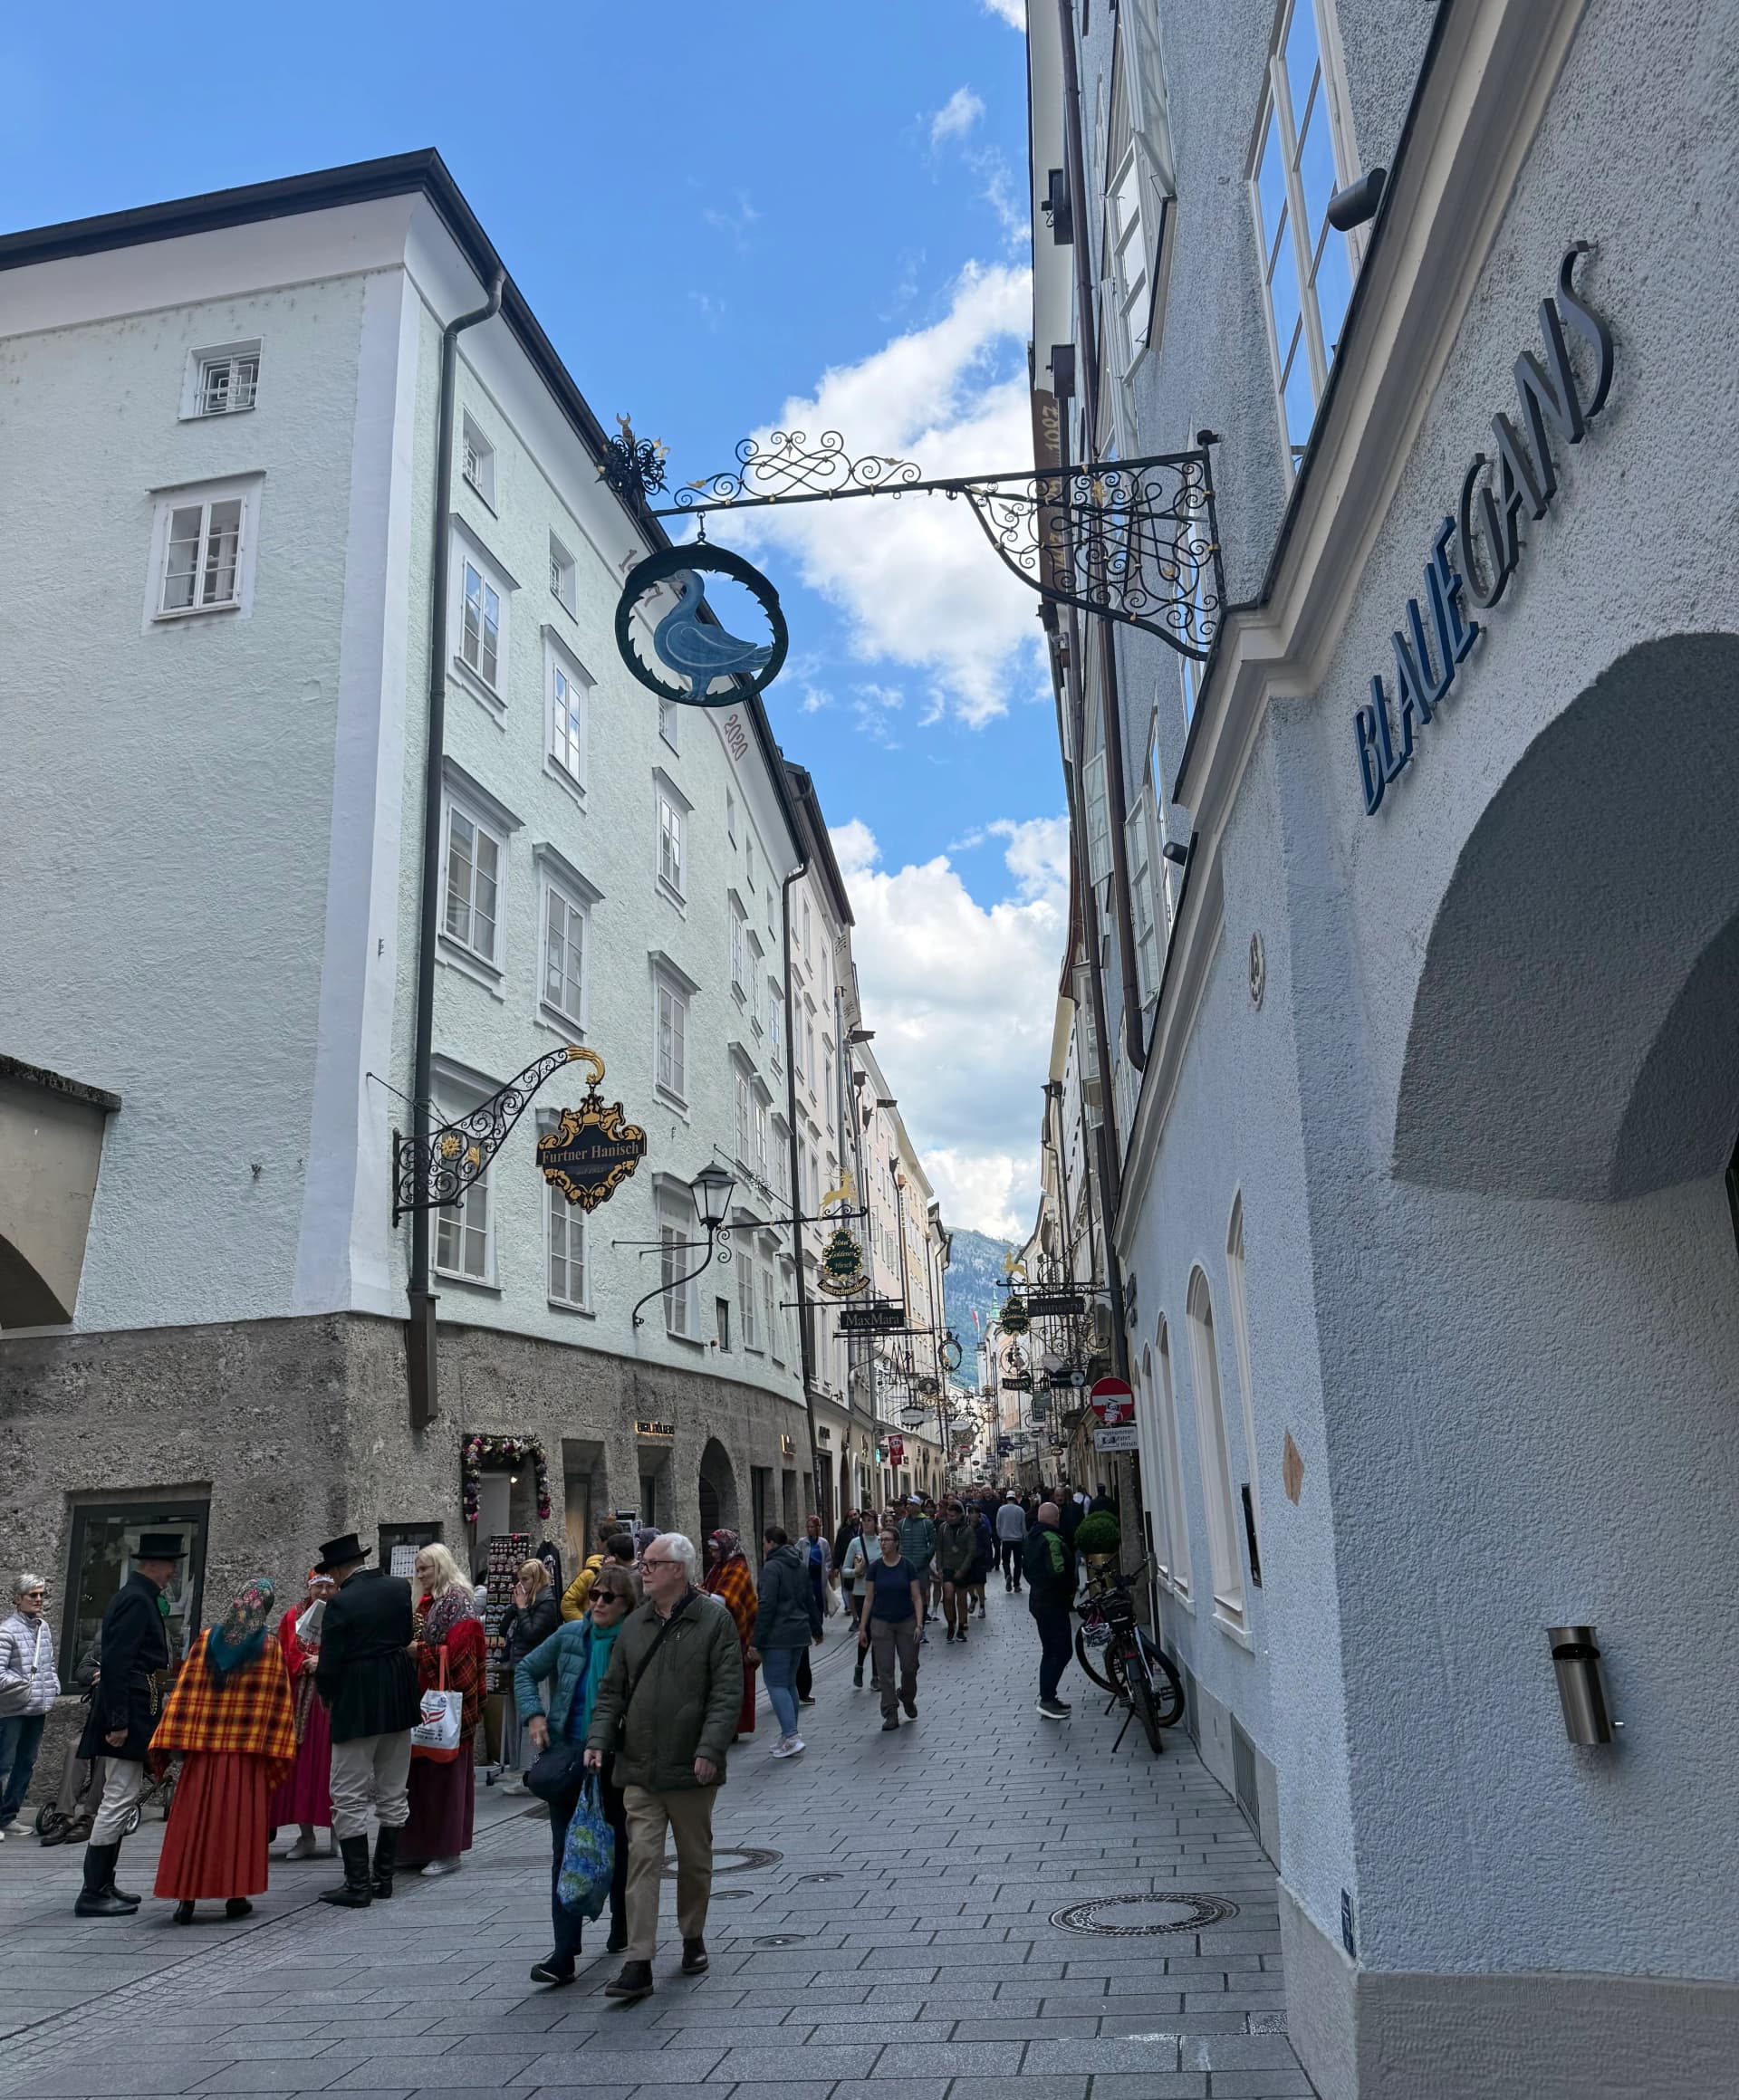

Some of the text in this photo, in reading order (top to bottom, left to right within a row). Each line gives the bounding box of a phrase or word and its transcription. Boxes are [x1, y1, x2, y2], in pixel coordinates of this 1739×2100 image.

[724, 714, 749, 762] 2020
[543, 1142, 639, 1165] Furtner Hanisch
[845, 1312, 900, 1327] MaxMara
